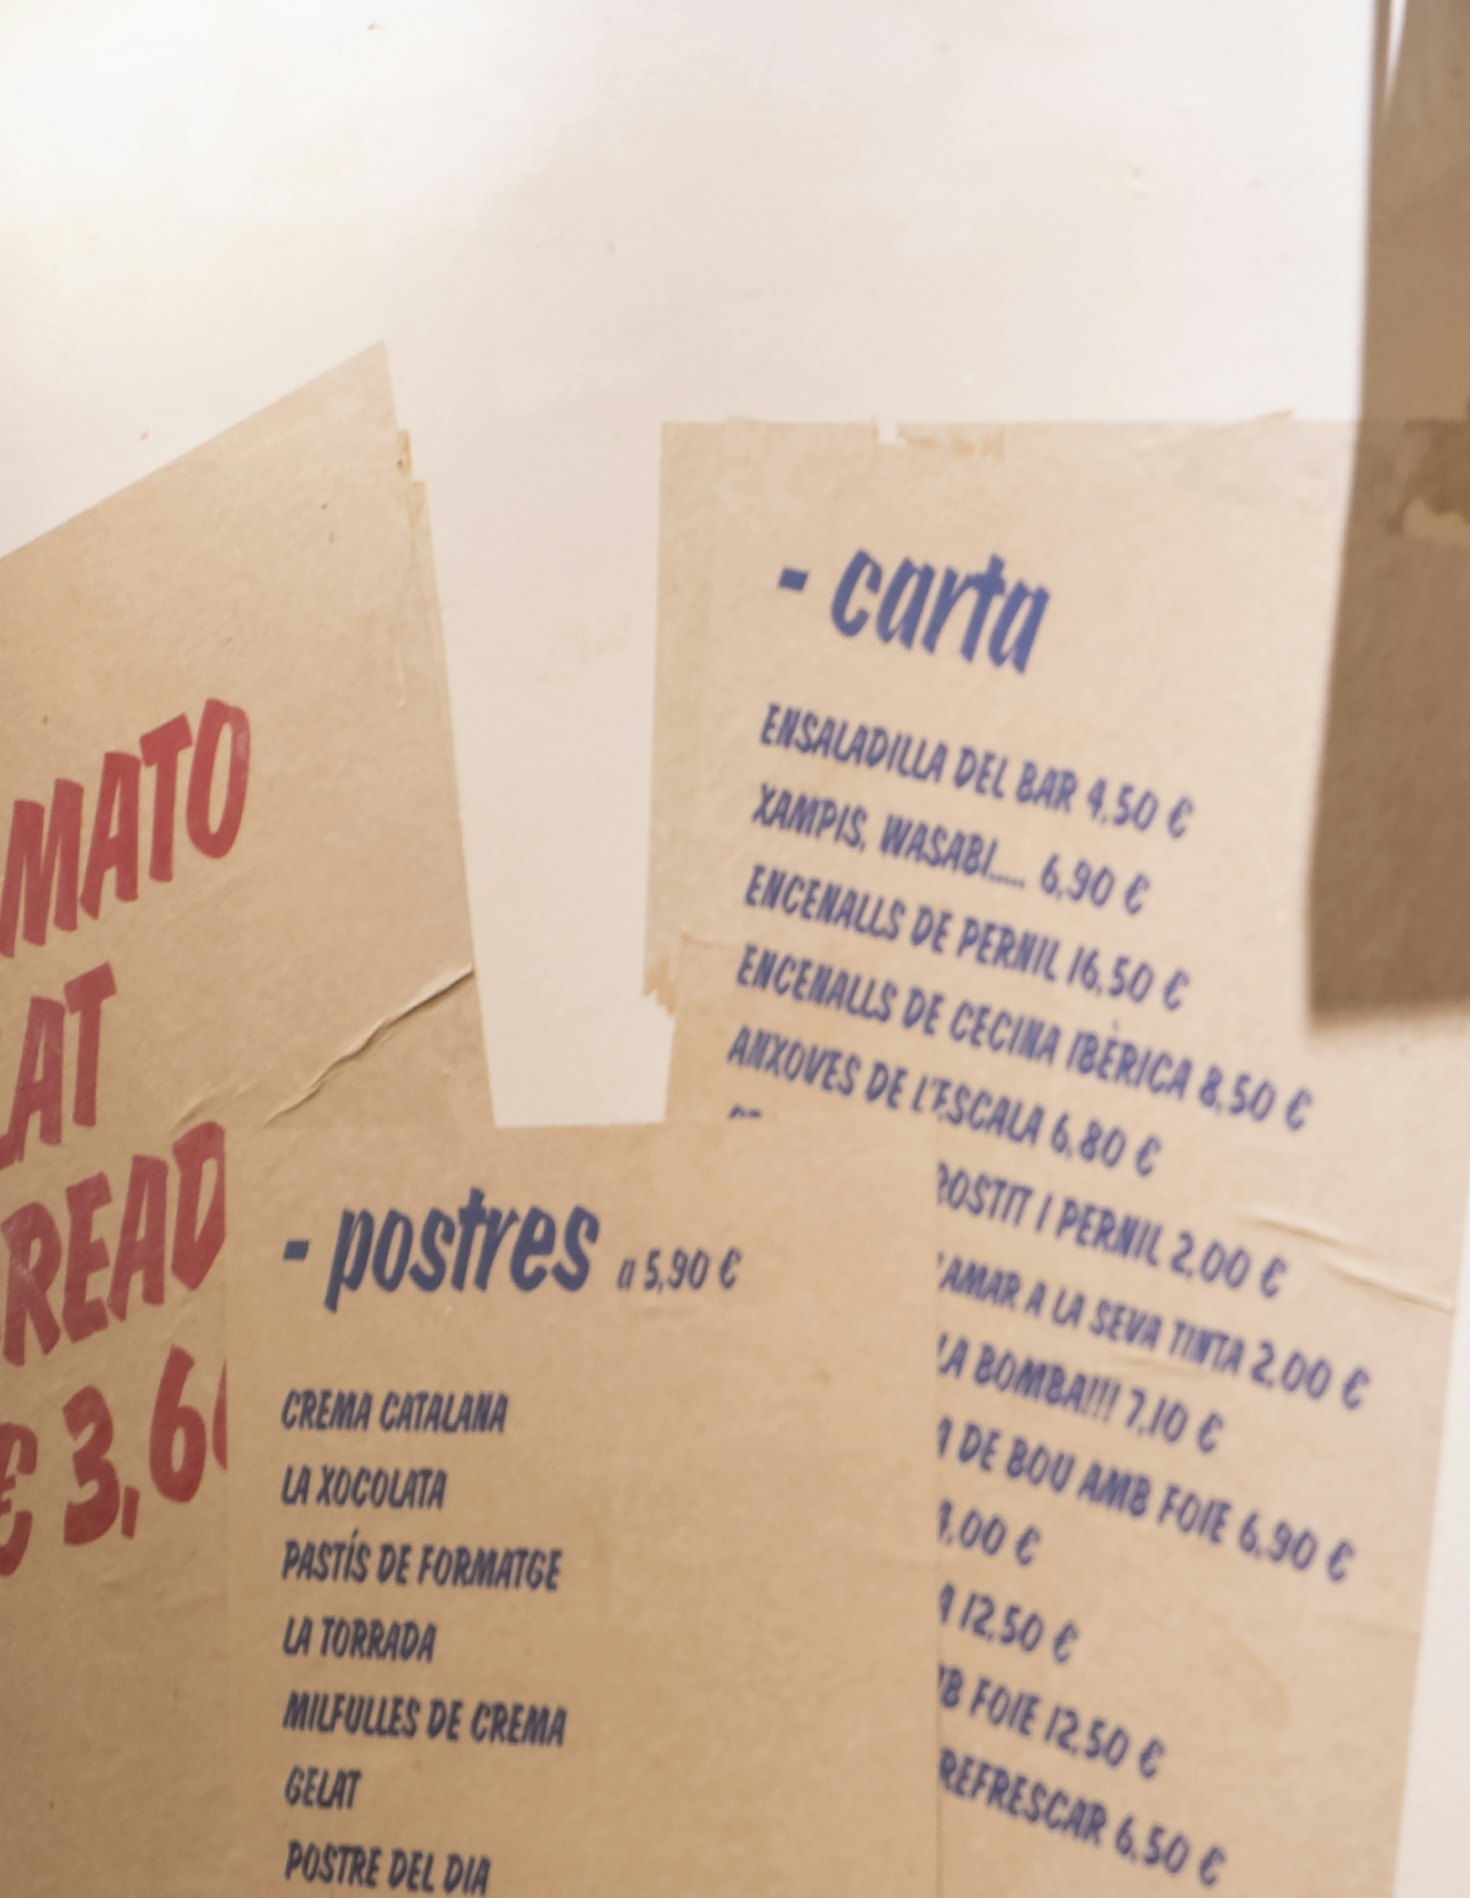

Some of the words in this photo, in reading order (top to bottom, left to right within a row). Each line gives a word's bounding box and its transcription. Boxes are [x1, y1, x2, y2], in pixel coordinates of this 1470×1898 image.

[830, 549, 1050, 674] carta
[760, 703, 944, 784] ENSALADILLA
[955, 745, 1008, 800] DEL
[1016, 759, 1078, 814] BAR
[1166, 797, 1195, 839] €
[0, 699, 250, 957] MATO
[1124, 875, 1150, 915] €
[0, 962, 116, 1170] AT
[736, 943, 896, 1023] ENCENALLS
[901, 986, 942, 1035] DE
[950, 1000, 1060, 1066] CECINA
[1286, 1088, 1313, 1130] €
[0, 1121, 225, 1367] READ
[324, 1187, 600, 1313] postres
[617, 1257, 635, 1292] a
[643, 1247, 709, 1294] 5,90
[719, 1246, 741, 1291] €
[63, 1345, 226, 1546] 3,6
[280, 1388, 373, 1432] CREMA
[379, 1390, 509, 1435] CATALANA
[281, 1465, 312, 1506] LA
[316, 1465, 448, 1511] XOCOLATA
[281, 1527, 371, 1584] PASTÍS
[377, 1543, 412, 1585] DE
[418, 1545, 563, 1592] FORMATGE
[282, 1616, 312, 1656] LA
[320, 1617, 438, 1663] TORRADA
[283, 1690, 420, 1739] MILFULLES
[427, 1699, 463, 1741] DE
[470, 1702, 567, 1747] CREMA
[284, 1767, 362, 1810] GELAT
[284, 1840, 381, 1888] POSTRE
[388, 1849, 434, 1895] DEL
[443, 1854, 491, 1898] DIA
